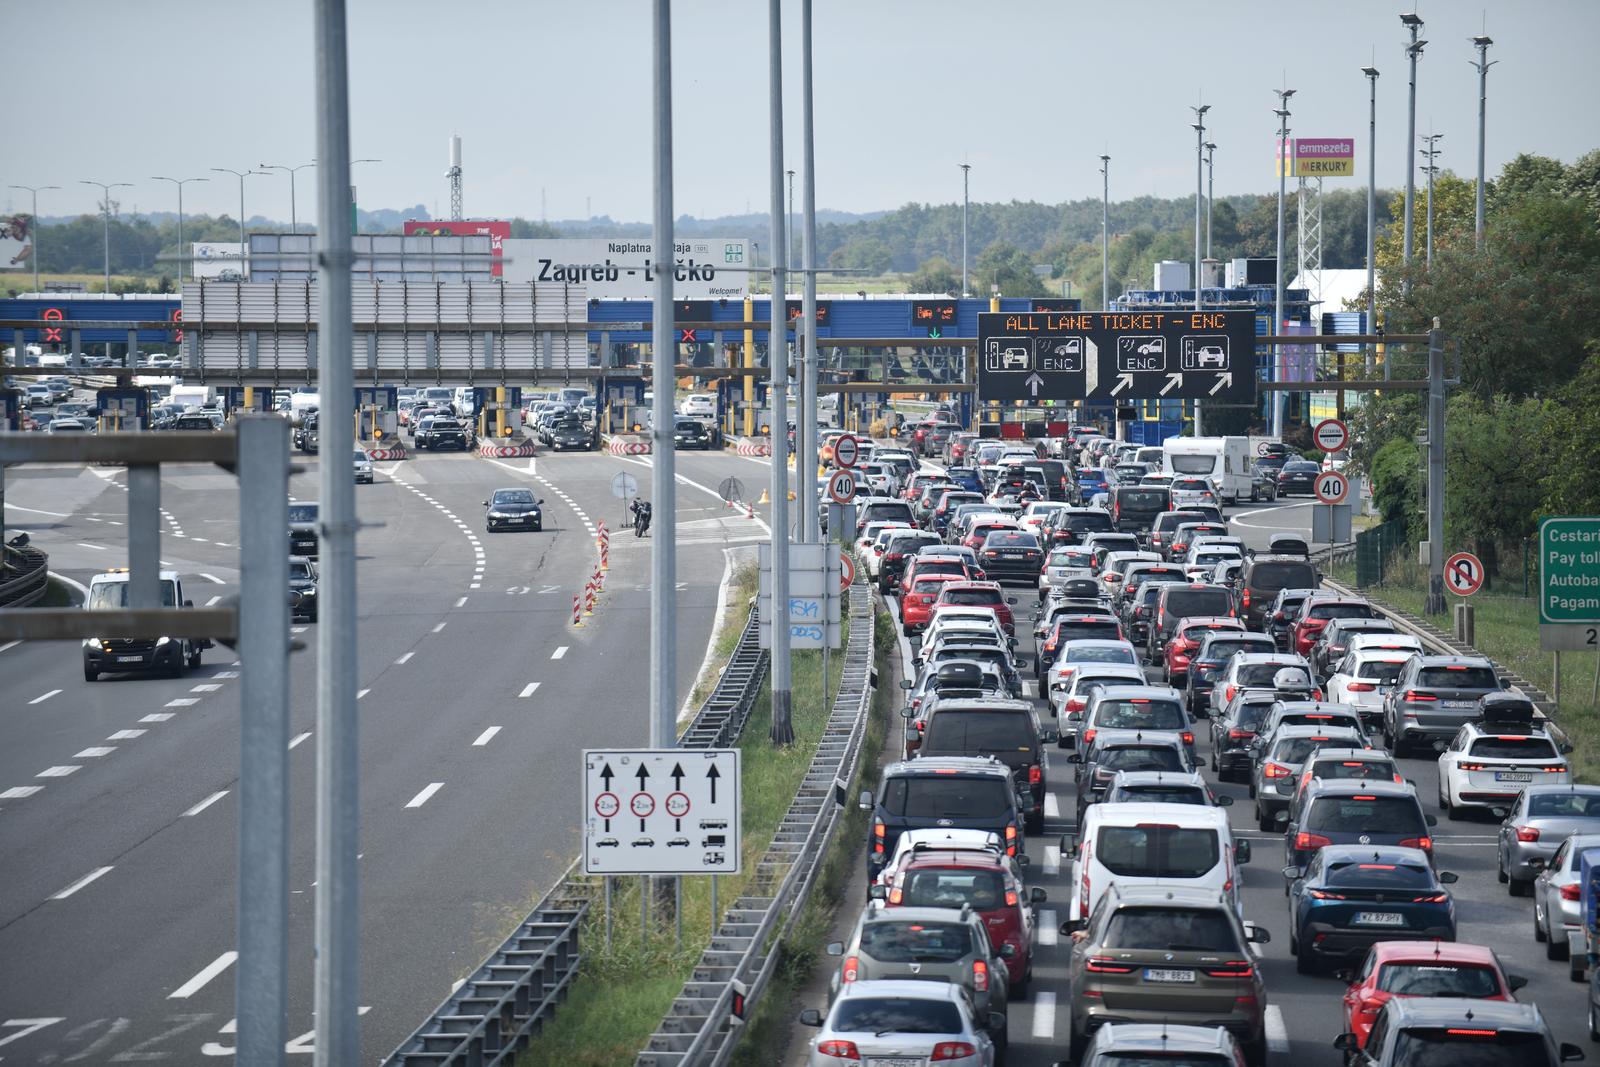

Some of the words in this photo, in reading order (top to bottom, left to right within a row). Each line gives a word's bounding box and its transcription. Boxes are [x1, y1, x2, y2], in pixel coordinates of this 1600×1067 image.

[1299, 142, 1351, 153] emmezeta
[1301, 161, 1348, 172] MERKURY
[608, 242, 651, 255] Naplatna
[538, 258, 619, 284] Zagreb
[645, 258, 715, 282] Lčko
[708, 287, 743, 296] Welcome!
[1006, 315, 1040, 331] ALL
[1046, 315, 1093, 331] LANE
[1101, 314, 1165, 330] TICKET
[1191, 314, 1226, 329] ENC
[1044, 358, 1074, 371] ENC
[1127, 357, 1157, 370] ENC
[836, 479, 851, 495] 40
[1322, 480, 1341, 496] 40
[1549, 551, 1576, 567] Pay
[1549, 573, 1600, 586] Autoba
[1586, 628, 1598, 645] 2
